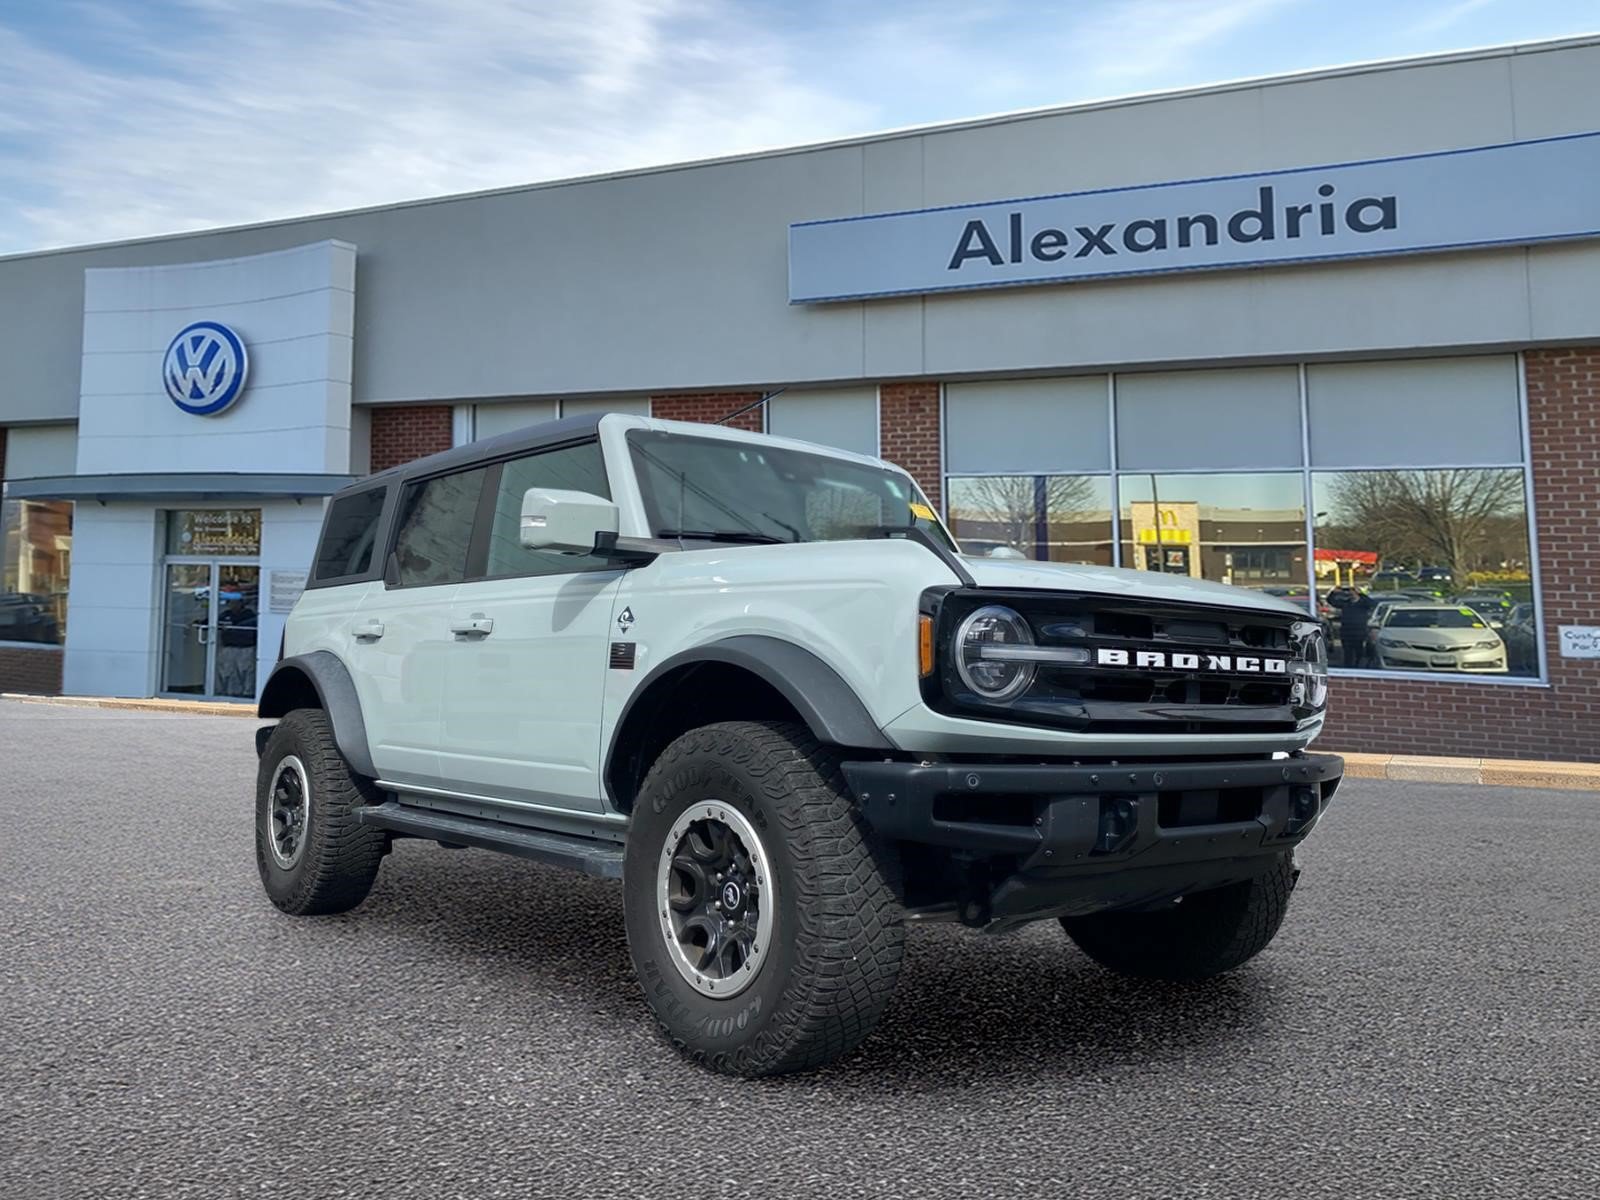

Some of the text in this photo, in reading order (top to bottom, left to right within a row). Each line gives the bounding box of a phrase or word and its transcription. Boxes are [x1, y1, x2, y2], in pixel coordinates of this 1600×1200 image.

[948, 184, 1398, 271] Alexandria
[168, 329, 236, 406] VW
[194, 513, 239, 524] Welcome
[1097, 648, 1286, 673] BRONCO
